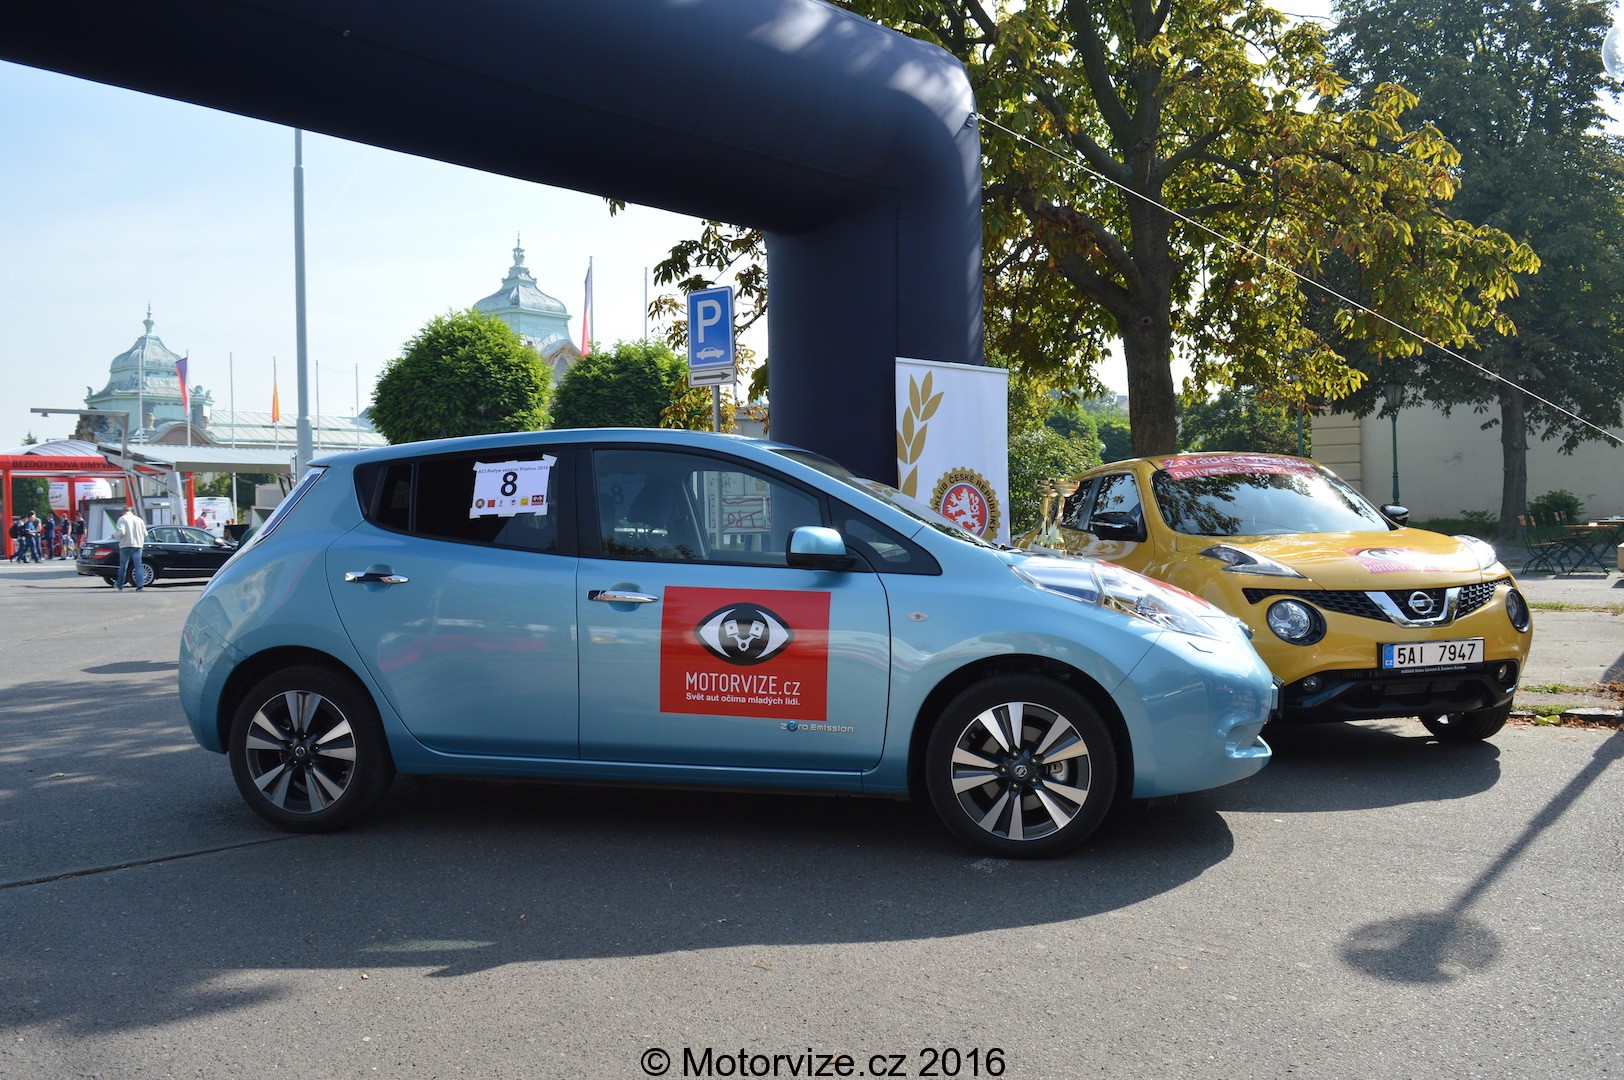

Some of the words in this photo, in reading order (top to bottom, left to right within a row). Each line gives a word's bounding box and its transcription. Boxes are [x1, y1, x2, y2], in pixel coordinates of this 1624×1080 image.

[697, 299, 722, 343] P
[500, 471, 518, 497] 8
[975, 480, 996, 532] REPUBLIKY
[1398, 646, 1423, 665] 5AI
[1439, 643, 1476, 662] 7947
[686, 692, 705, 701] Svět
[706, 694, 720, 702] aut
[721, 694, 746, 703] očima
[748, 696, 783, 706] mladých
[810, 723, 854, 733] Emission
